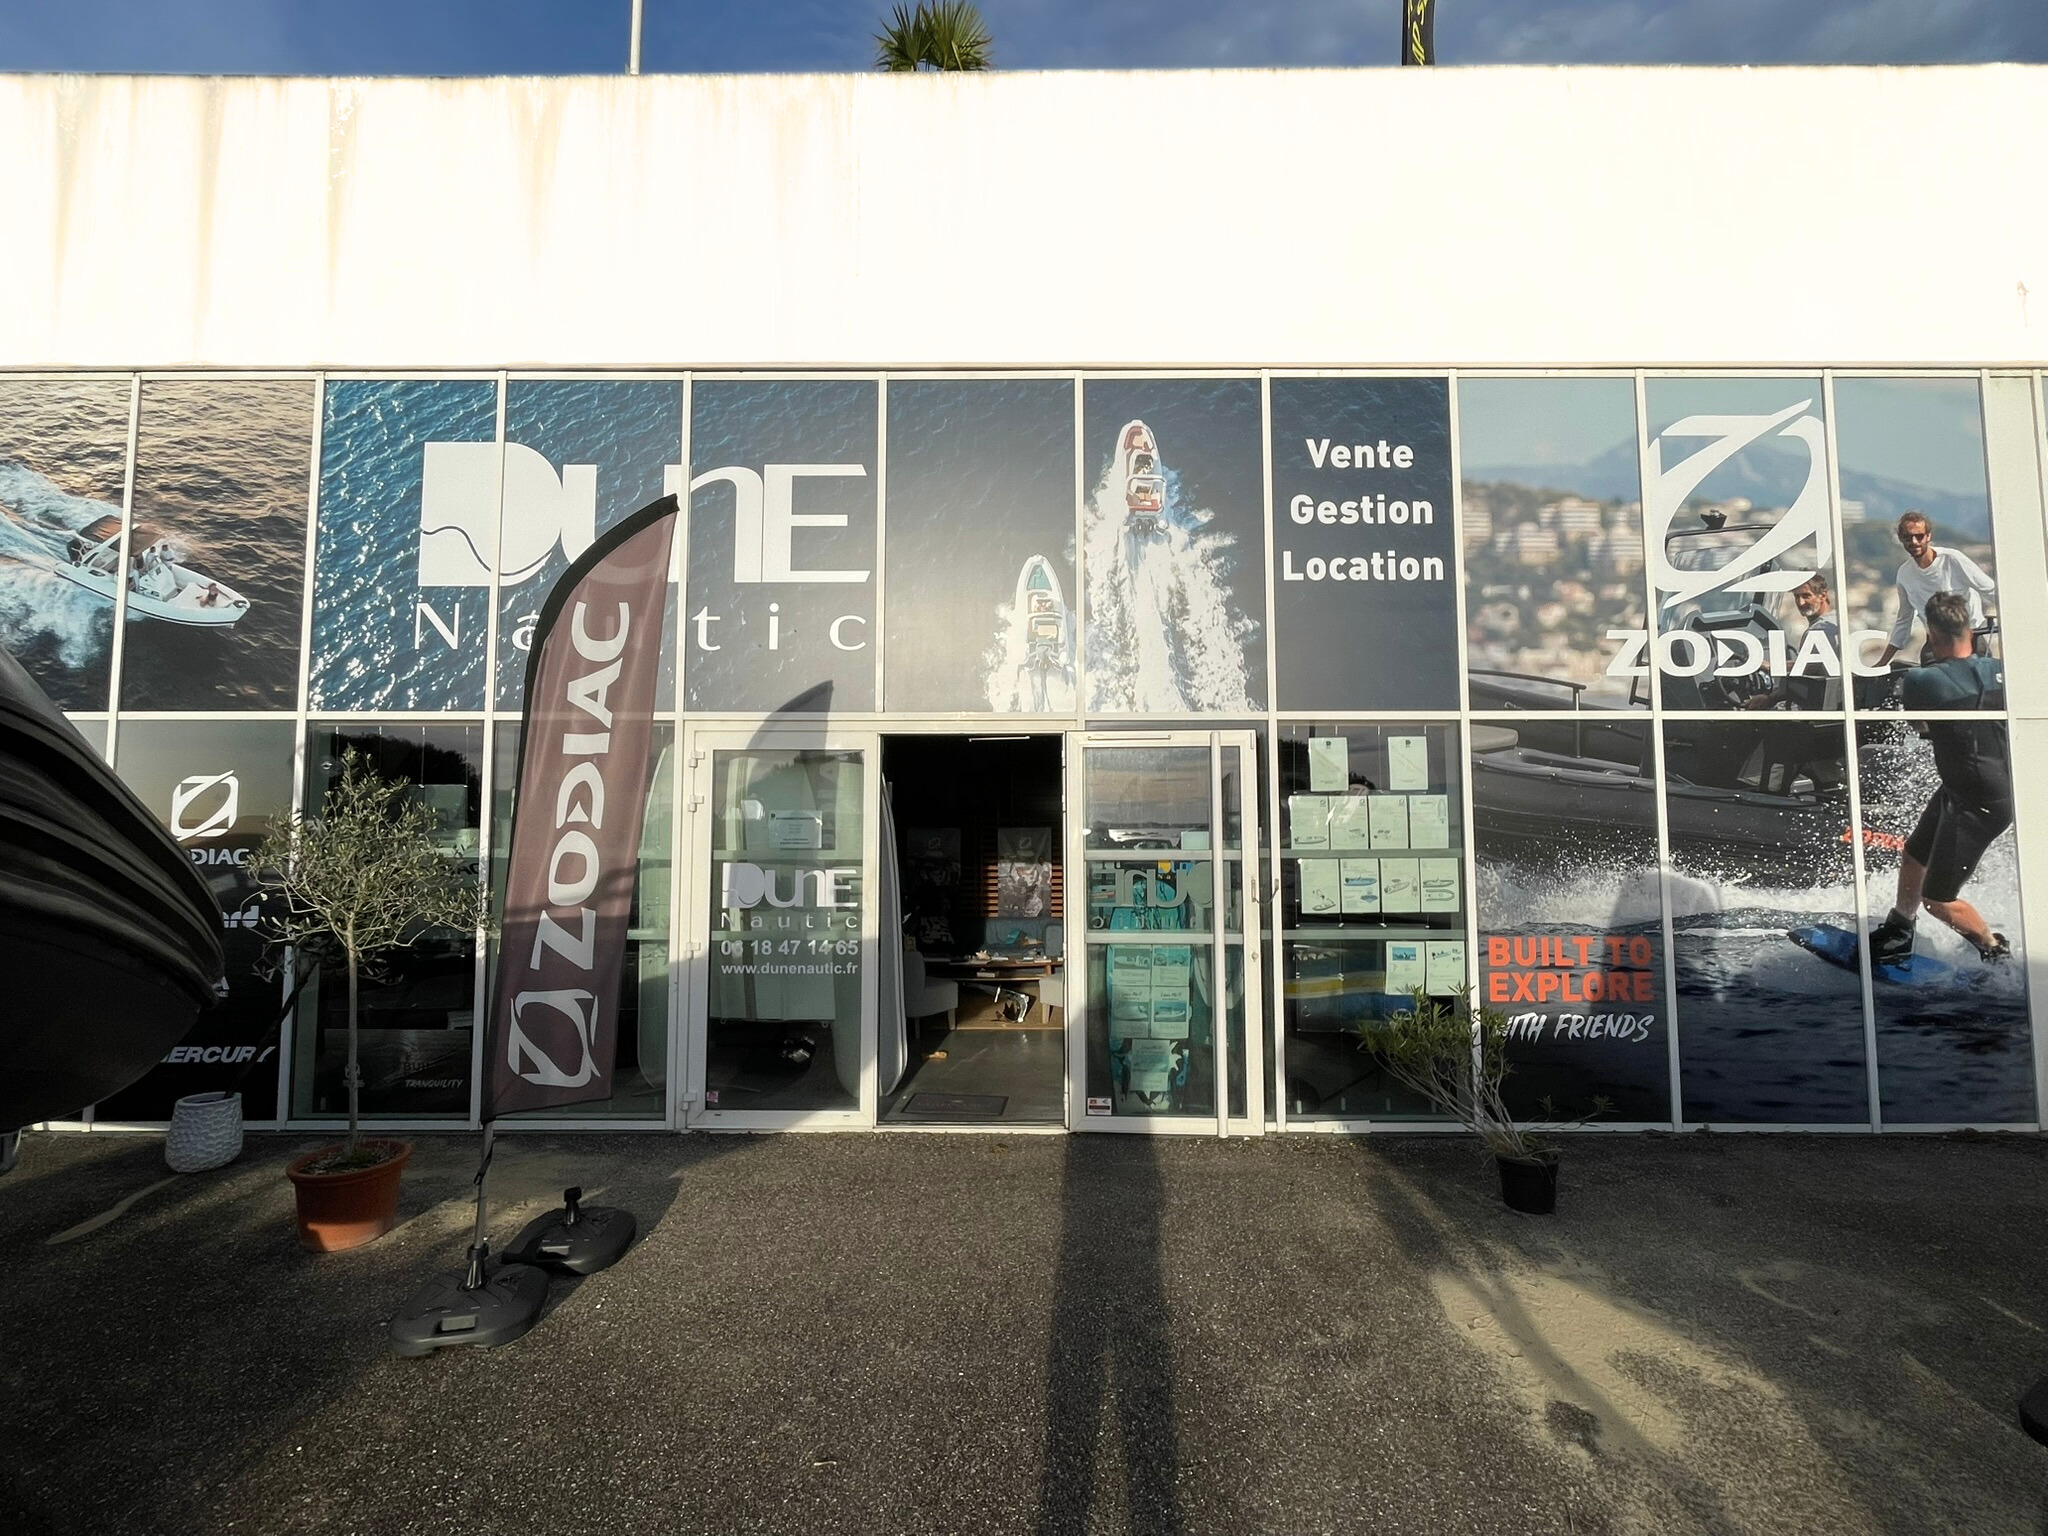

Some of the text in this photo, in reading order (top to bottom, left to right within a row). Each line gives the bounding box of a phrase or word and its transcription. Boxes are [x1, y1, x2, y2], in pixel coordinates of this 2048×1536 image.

[1306, 438, 1414, 469] Vente
[1290, 494, 1433, 525] Gestion
[1283, 550, 1444, 581] Location
[1606, 629, 1892, 678] ZODIAC
[530, 600, 630, 970] ZODIAC
[189, 848, 250, 866] DIAC
[721, 912, 858, 929] Nautic
[750, 939, 772, 955] 18
[778, 940, 801, 955] 47
[808, 939, 831, 955] 14
[835, 940, 859, 956] 65
[1487, 935, 1653, 967] BUILT TO
[721, 962, 859, 975] www.dunenautic.fr
[1488, 971, 1654, 1003] EXPLORE
[1553, 1012, 1654, 1043] FRIENDS
[161, 1046, 276, 1063] ERCURY
